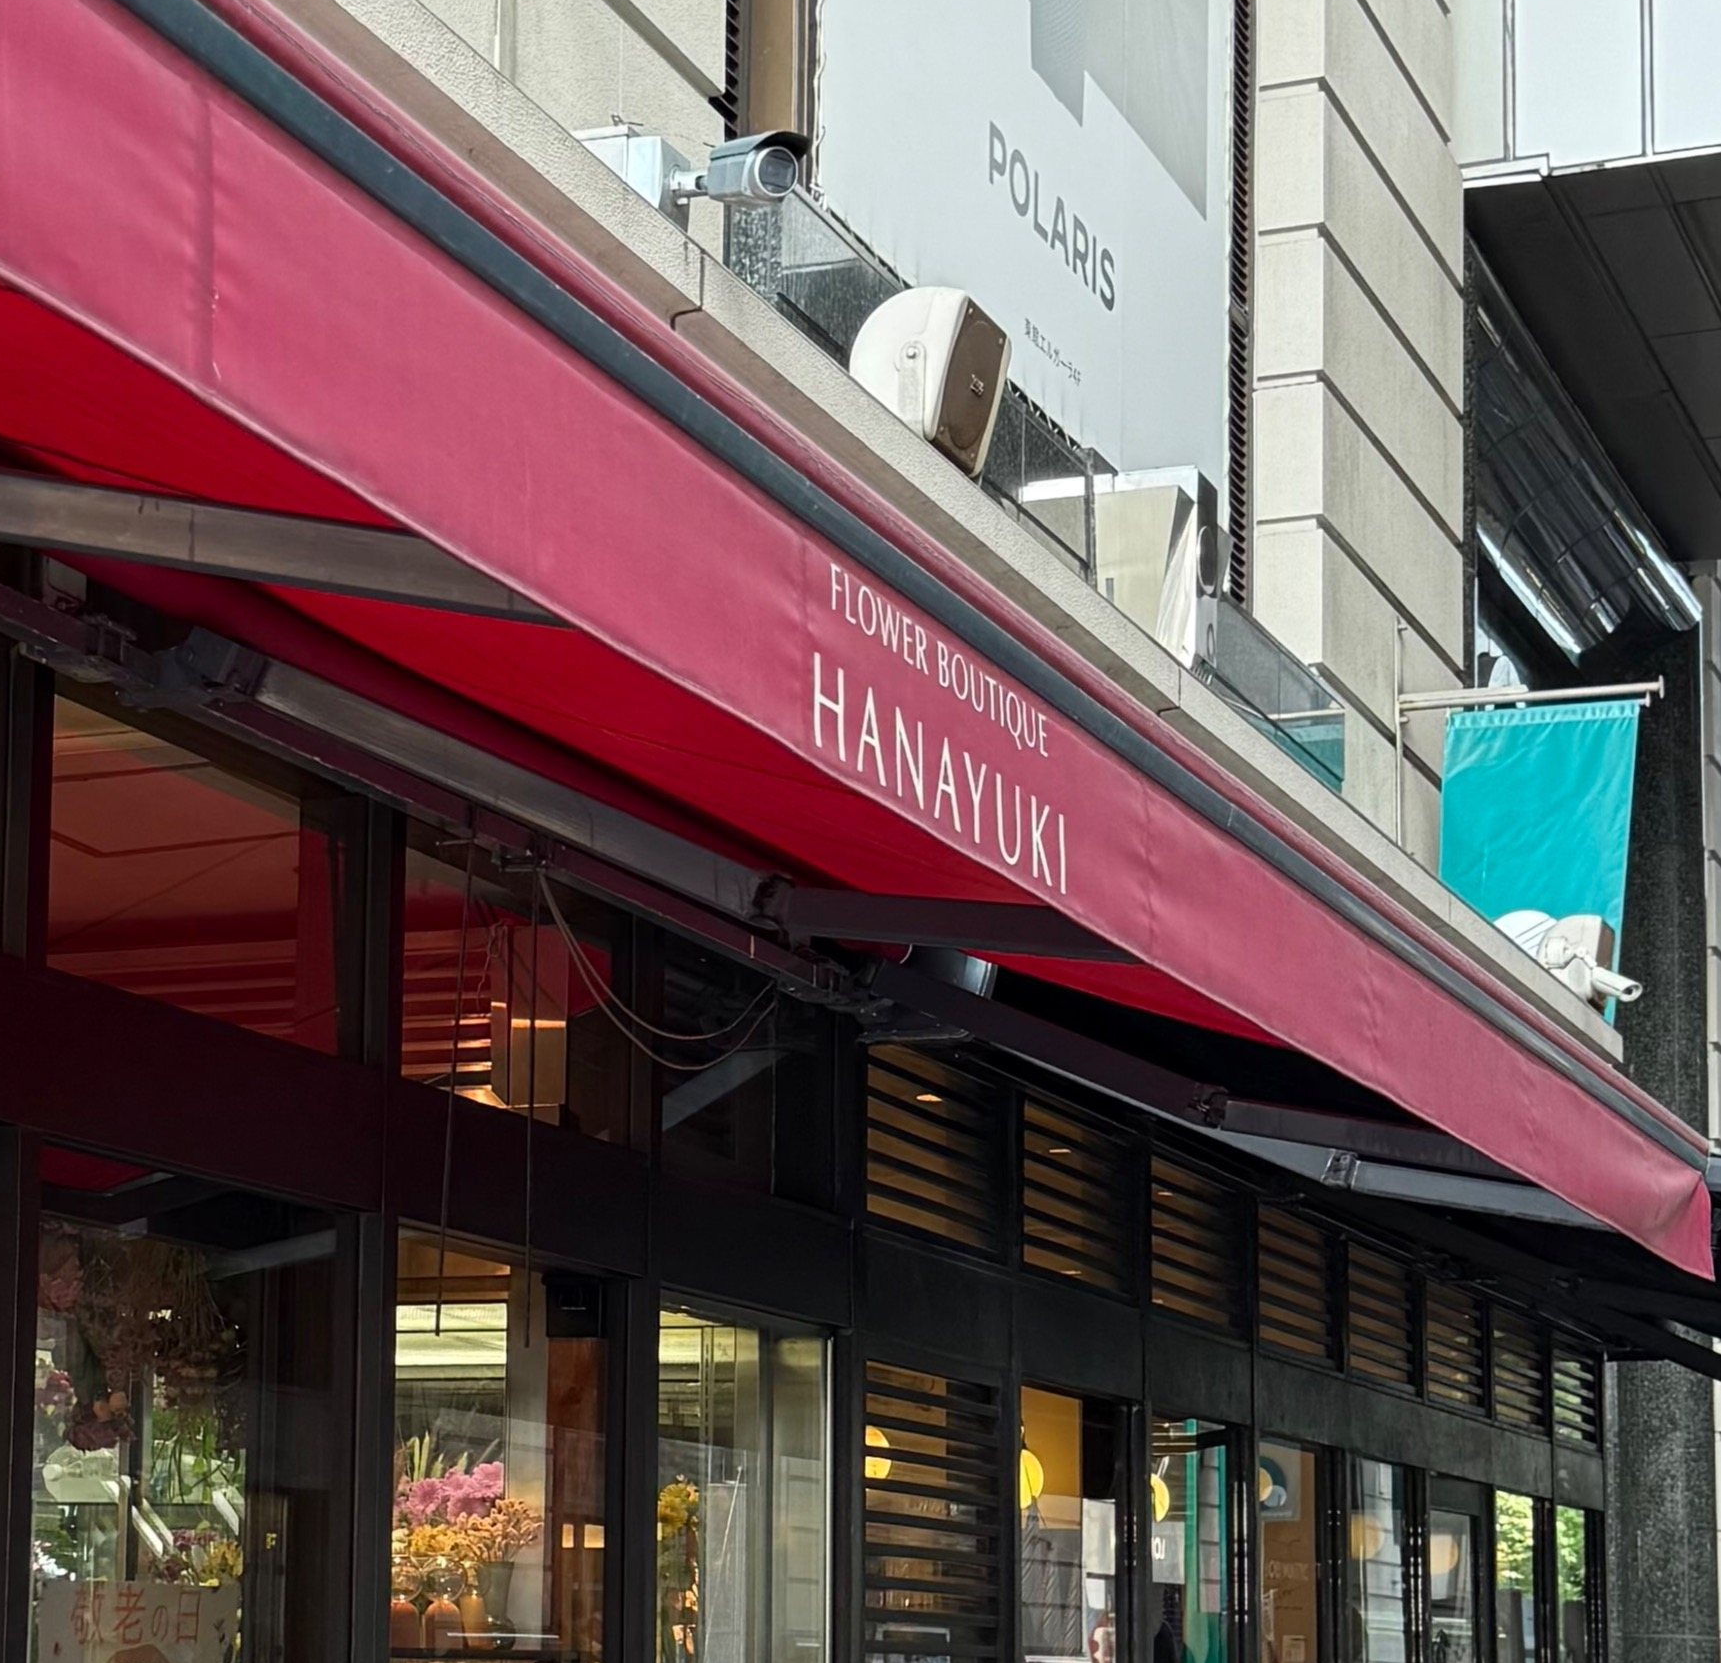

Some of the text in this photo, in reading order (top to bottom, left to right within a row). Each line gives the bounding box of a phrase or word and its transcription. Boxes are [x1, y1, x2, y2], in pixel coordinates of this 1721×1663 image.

[989, 120, 1116, 313] POLARIS
[829, 563, 1049, 758] FLOWER BOUTIQUE
[813, 652, 1068, 895] HANAYUKI
